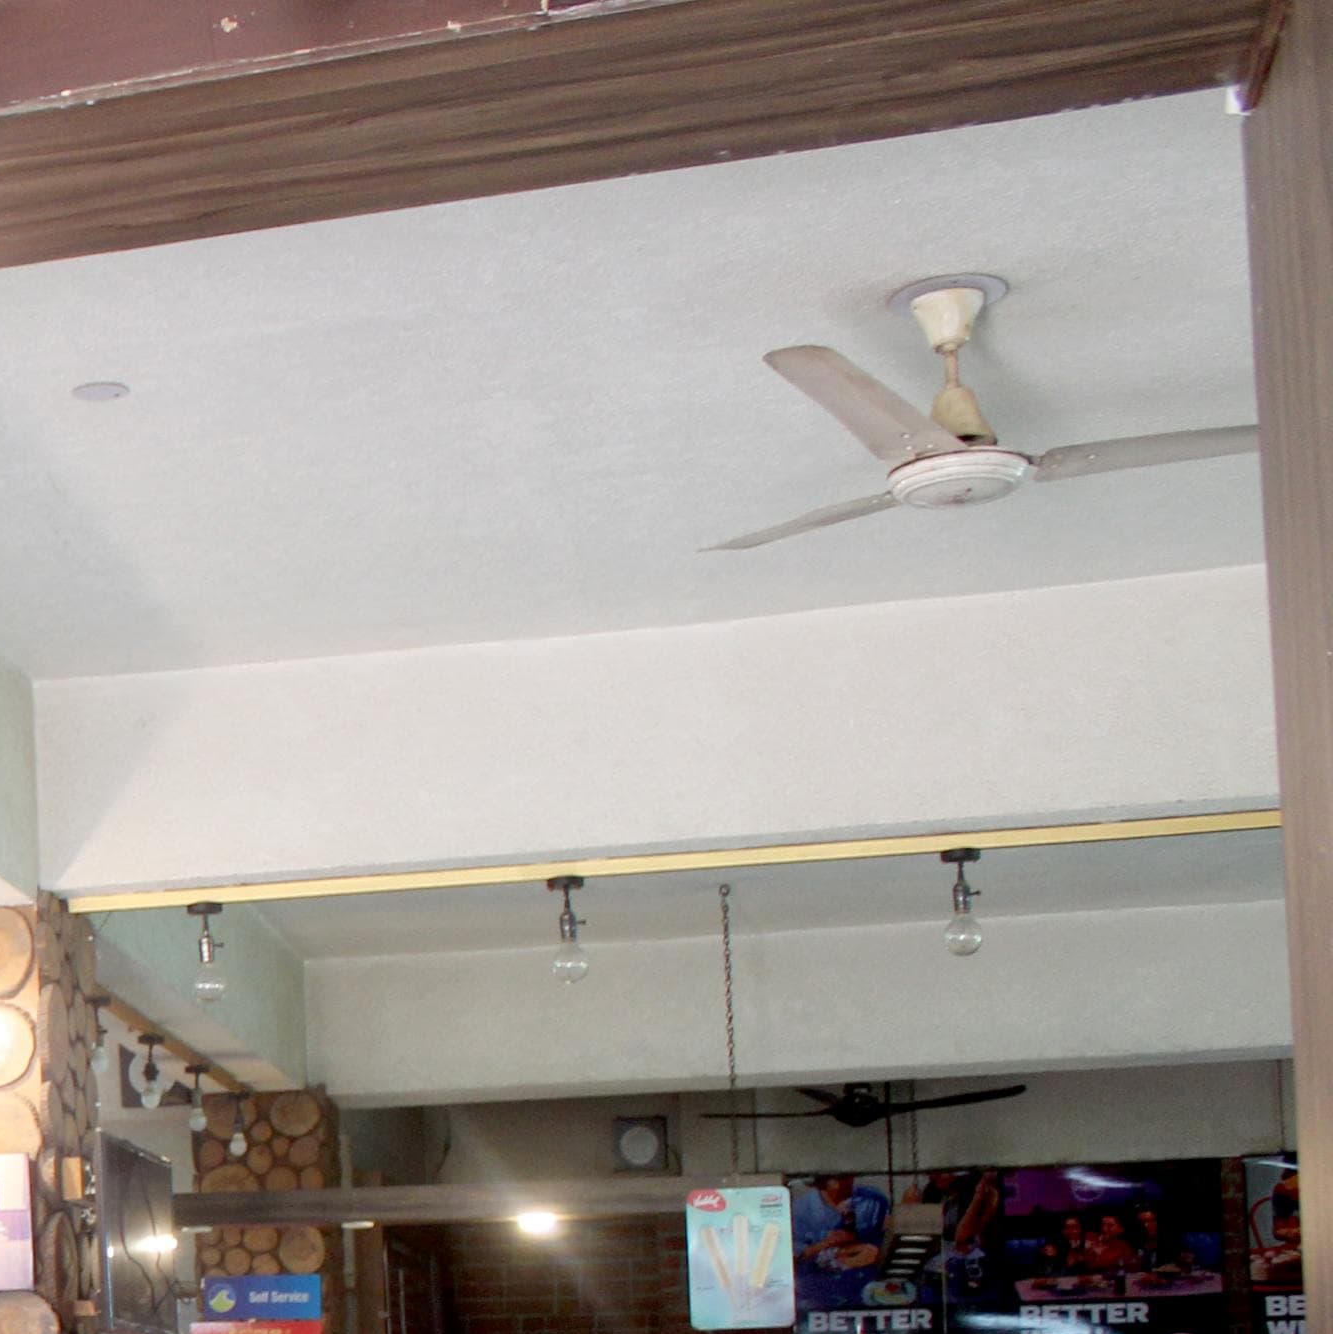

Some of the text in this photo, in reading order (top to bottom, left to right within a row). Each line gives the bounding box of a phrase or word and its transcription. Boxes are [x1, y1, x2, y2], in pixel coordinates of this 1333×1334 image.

[249, 1291, 310, 1303] Self Service
[808, 1308, 932, 1332] BETTER
[1020, 1302, 1149, 1324] BETTER
